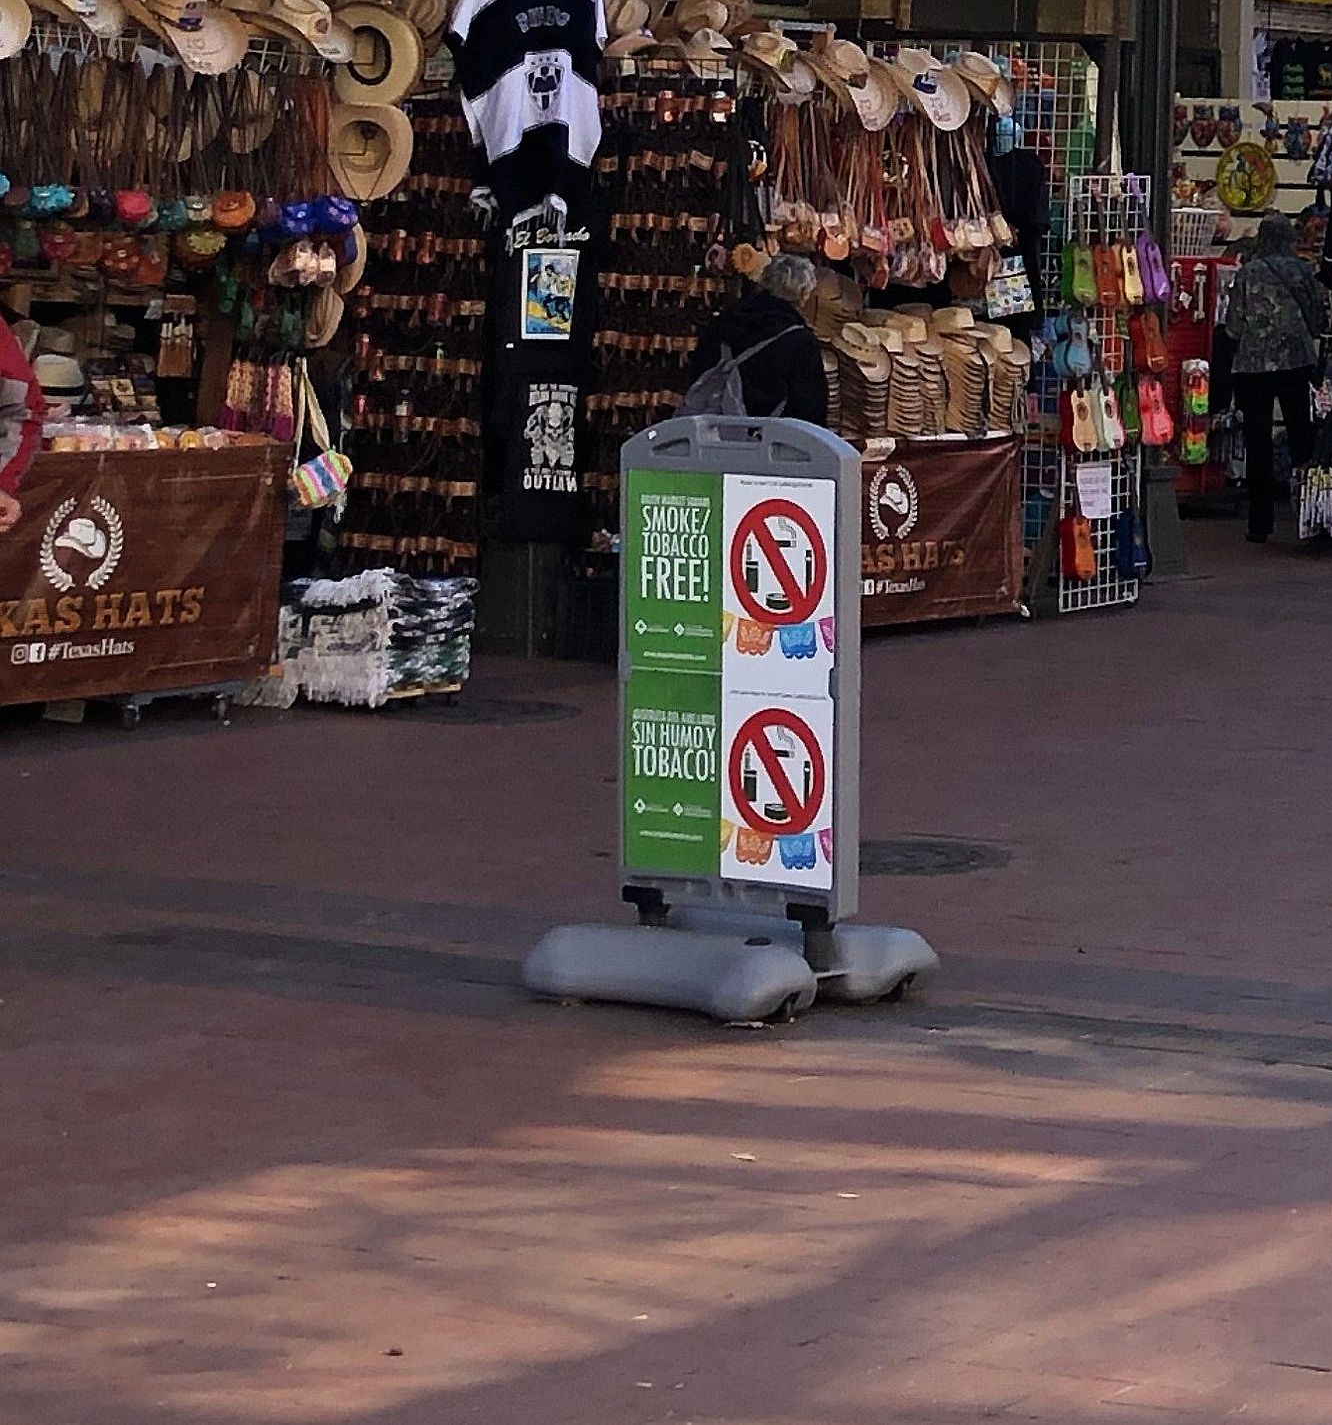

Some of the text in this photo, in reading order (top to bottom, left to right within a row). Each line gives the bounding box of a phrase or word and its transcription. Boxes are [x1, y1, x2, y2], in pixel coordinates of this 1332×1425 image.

[641, 505, 711, 534] SMOKE/
[641, 532, 709, 559] TOBACCO
[641, 556, 710, 602] FREE!
[92, 586, 205, 630] HATS
[48, 638, 135, 661] #TexasHats
[633, 722, 716, 750] SIN HUMO Y
[633, 745, 716, 782] TOBACO!
